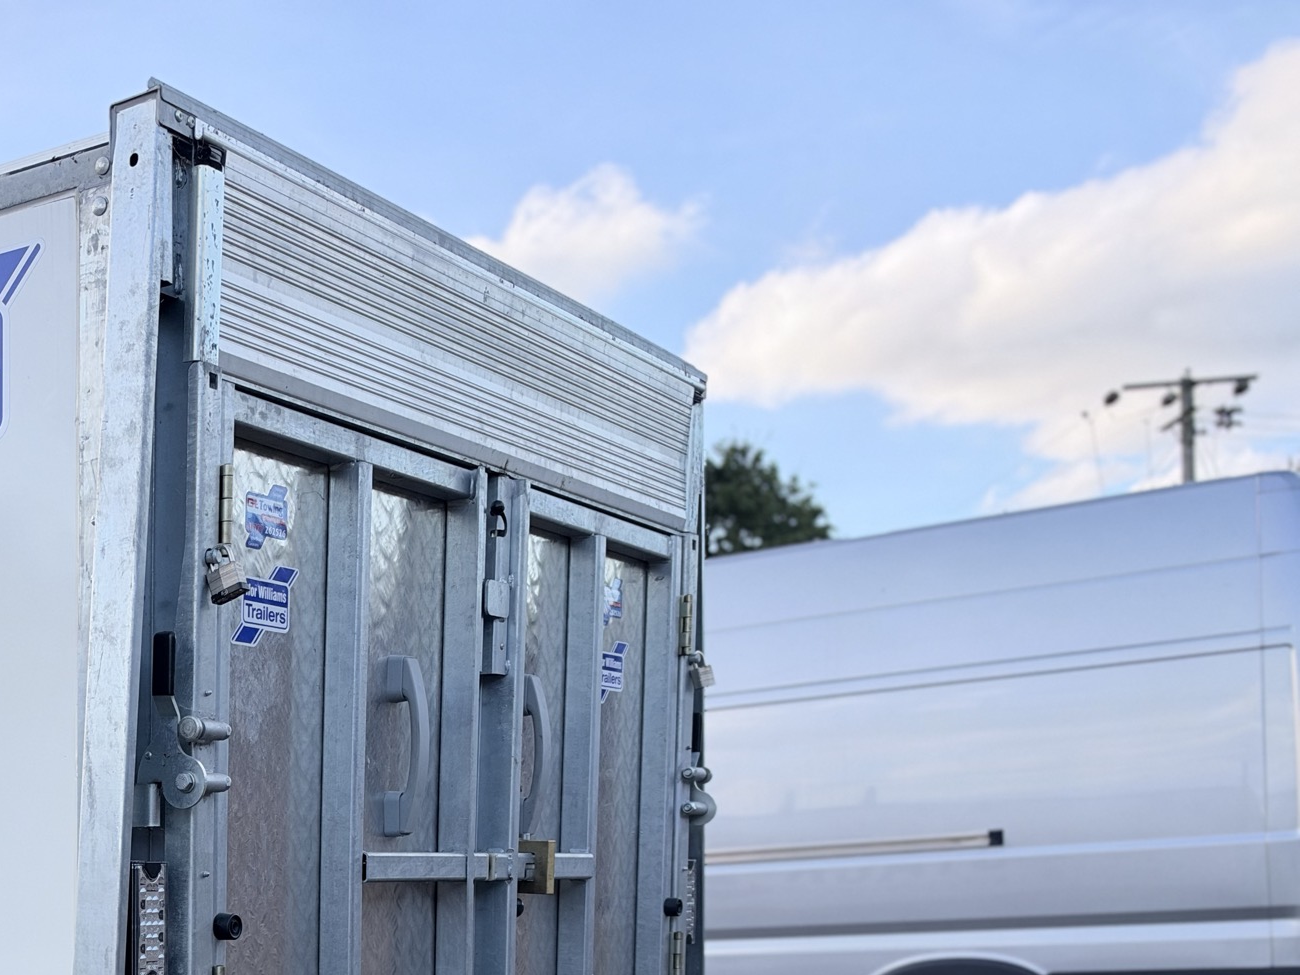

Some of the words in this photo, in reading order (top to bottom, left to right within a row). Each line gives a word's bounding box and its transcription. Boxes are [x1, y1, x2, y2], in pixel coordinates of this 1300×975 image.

[246, 583, 257, 597] for
[258, 585, 287, 604] Williams
[246, 603, 286, 624] Trailers
[601, 672, 622, 686] railers
